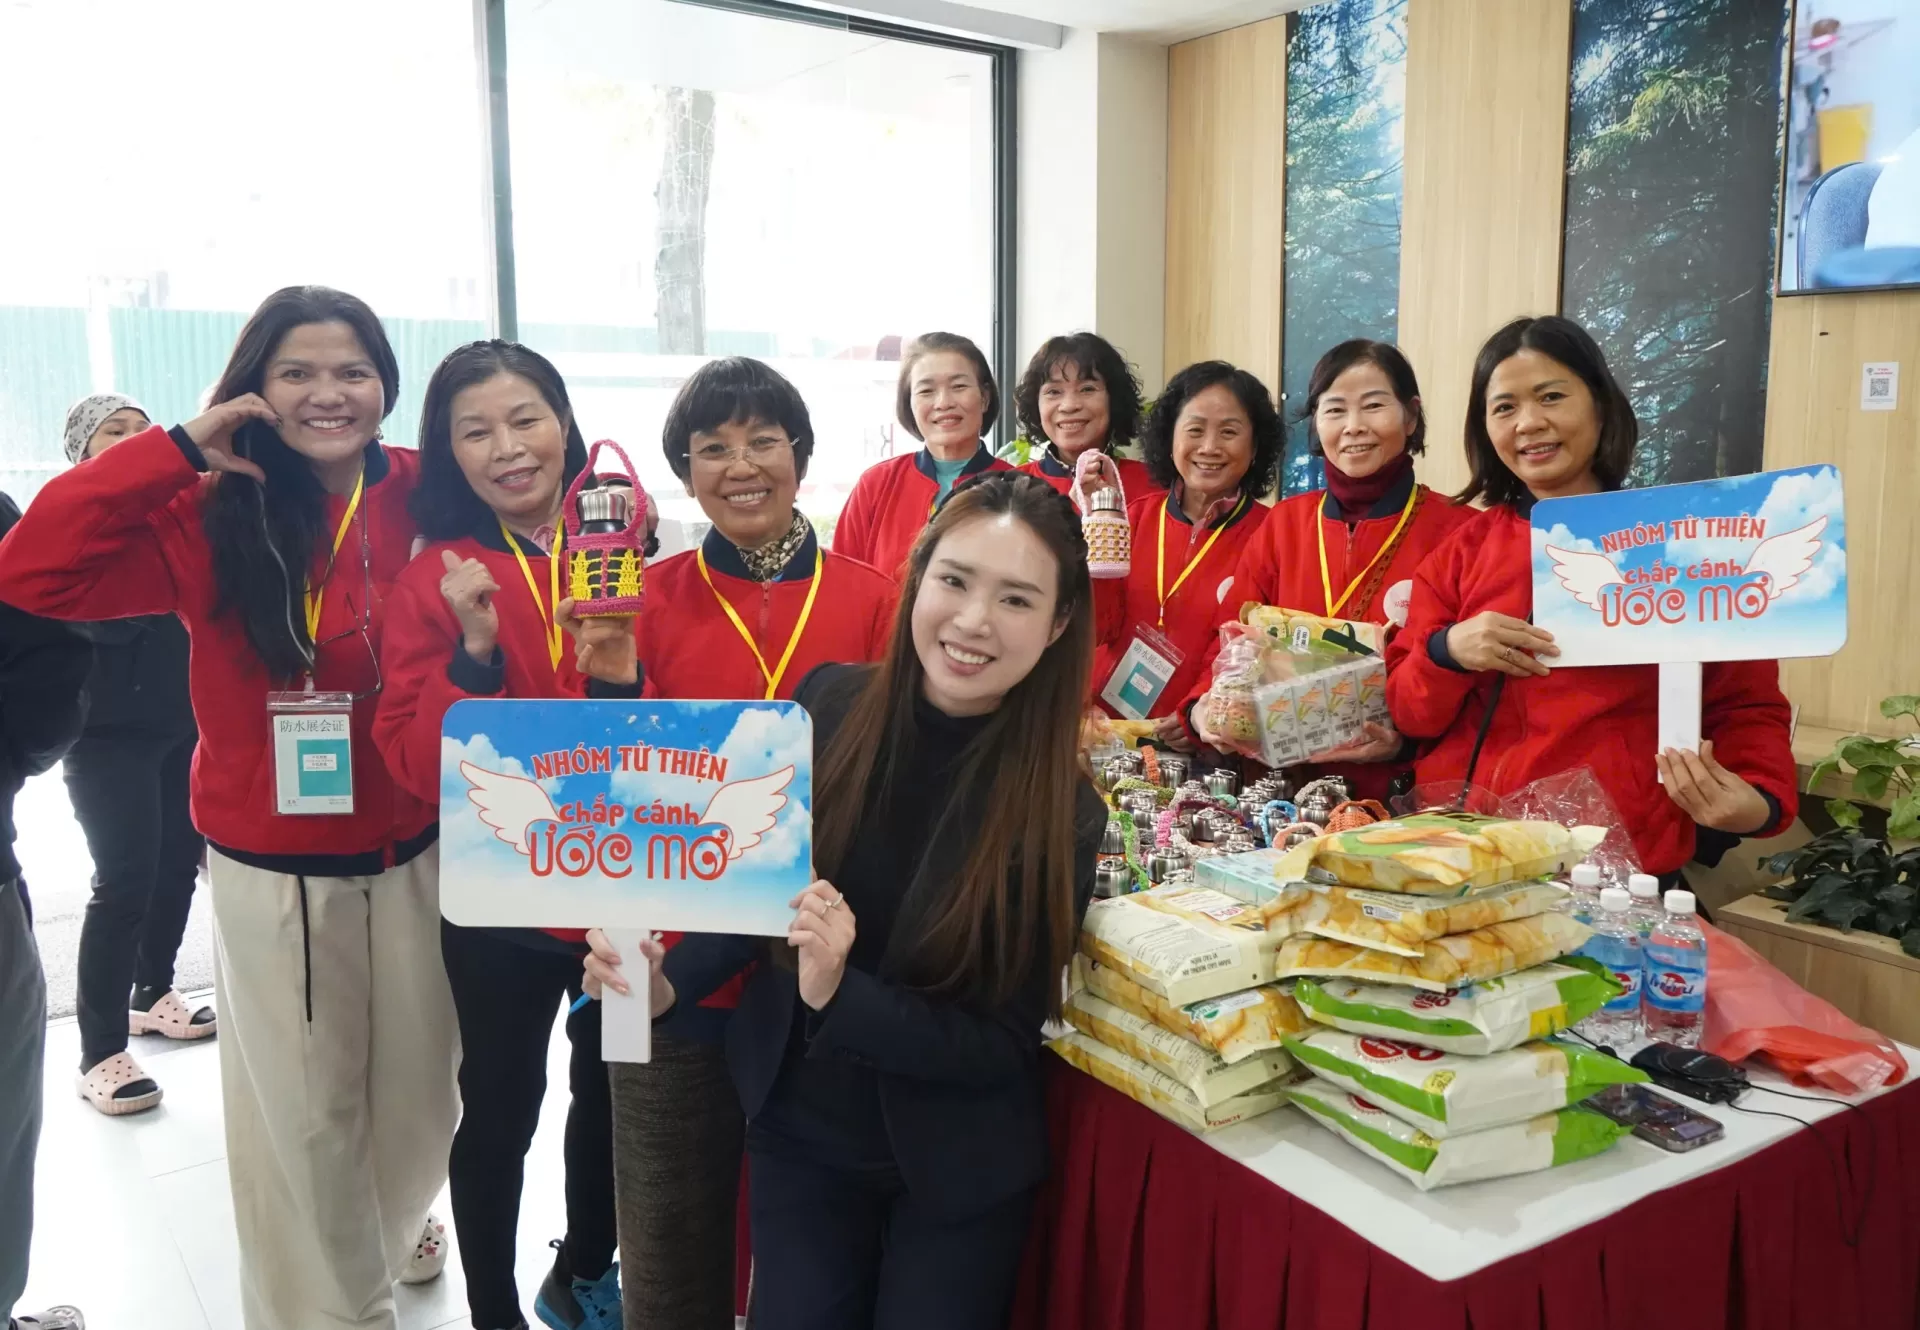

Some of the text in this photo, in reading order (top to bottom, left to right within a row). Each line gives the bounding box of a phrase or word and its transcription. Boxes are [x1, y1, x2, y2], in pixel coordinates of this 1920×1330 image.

[1599, 512, 1766, 554] NHÓM TỪ THIỆN
[1686, 557, 1743, 580] cánh
[1601, 582, 1687, 627] ƯỚC
[280, 718, 345, 733] 防水展会证
[531, 740, 729, 784] NHÓM TỪ THIỆN
[634, 798, 700, 826] cánh
[530, 822, 633, 879] ƯỚC
